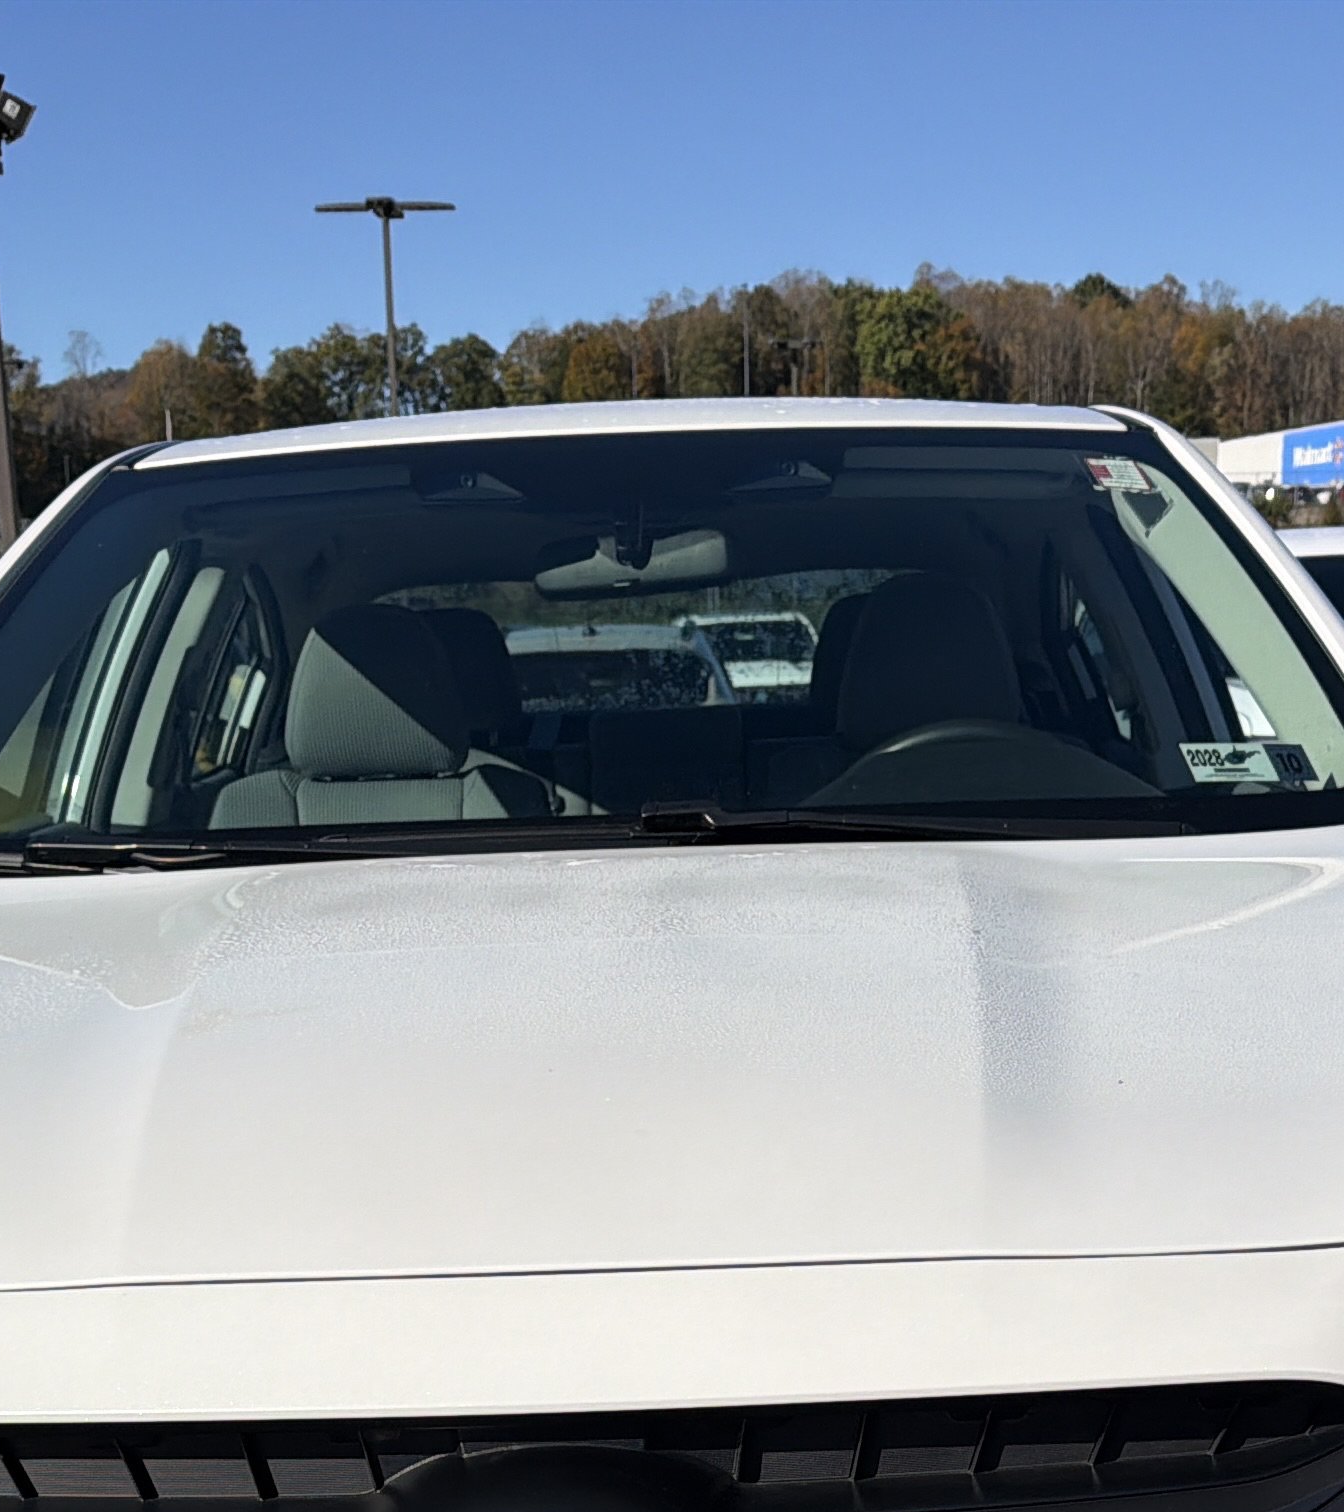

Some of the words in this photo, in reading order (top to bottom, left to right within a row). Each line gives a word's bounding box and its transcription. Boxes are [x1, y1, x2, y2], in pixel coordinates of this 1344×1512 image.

[1292, 441, 1333, 468] Walmart
[1187, 749, 1225, 767] 2028
[1276, 752, 1304, 774] 10
